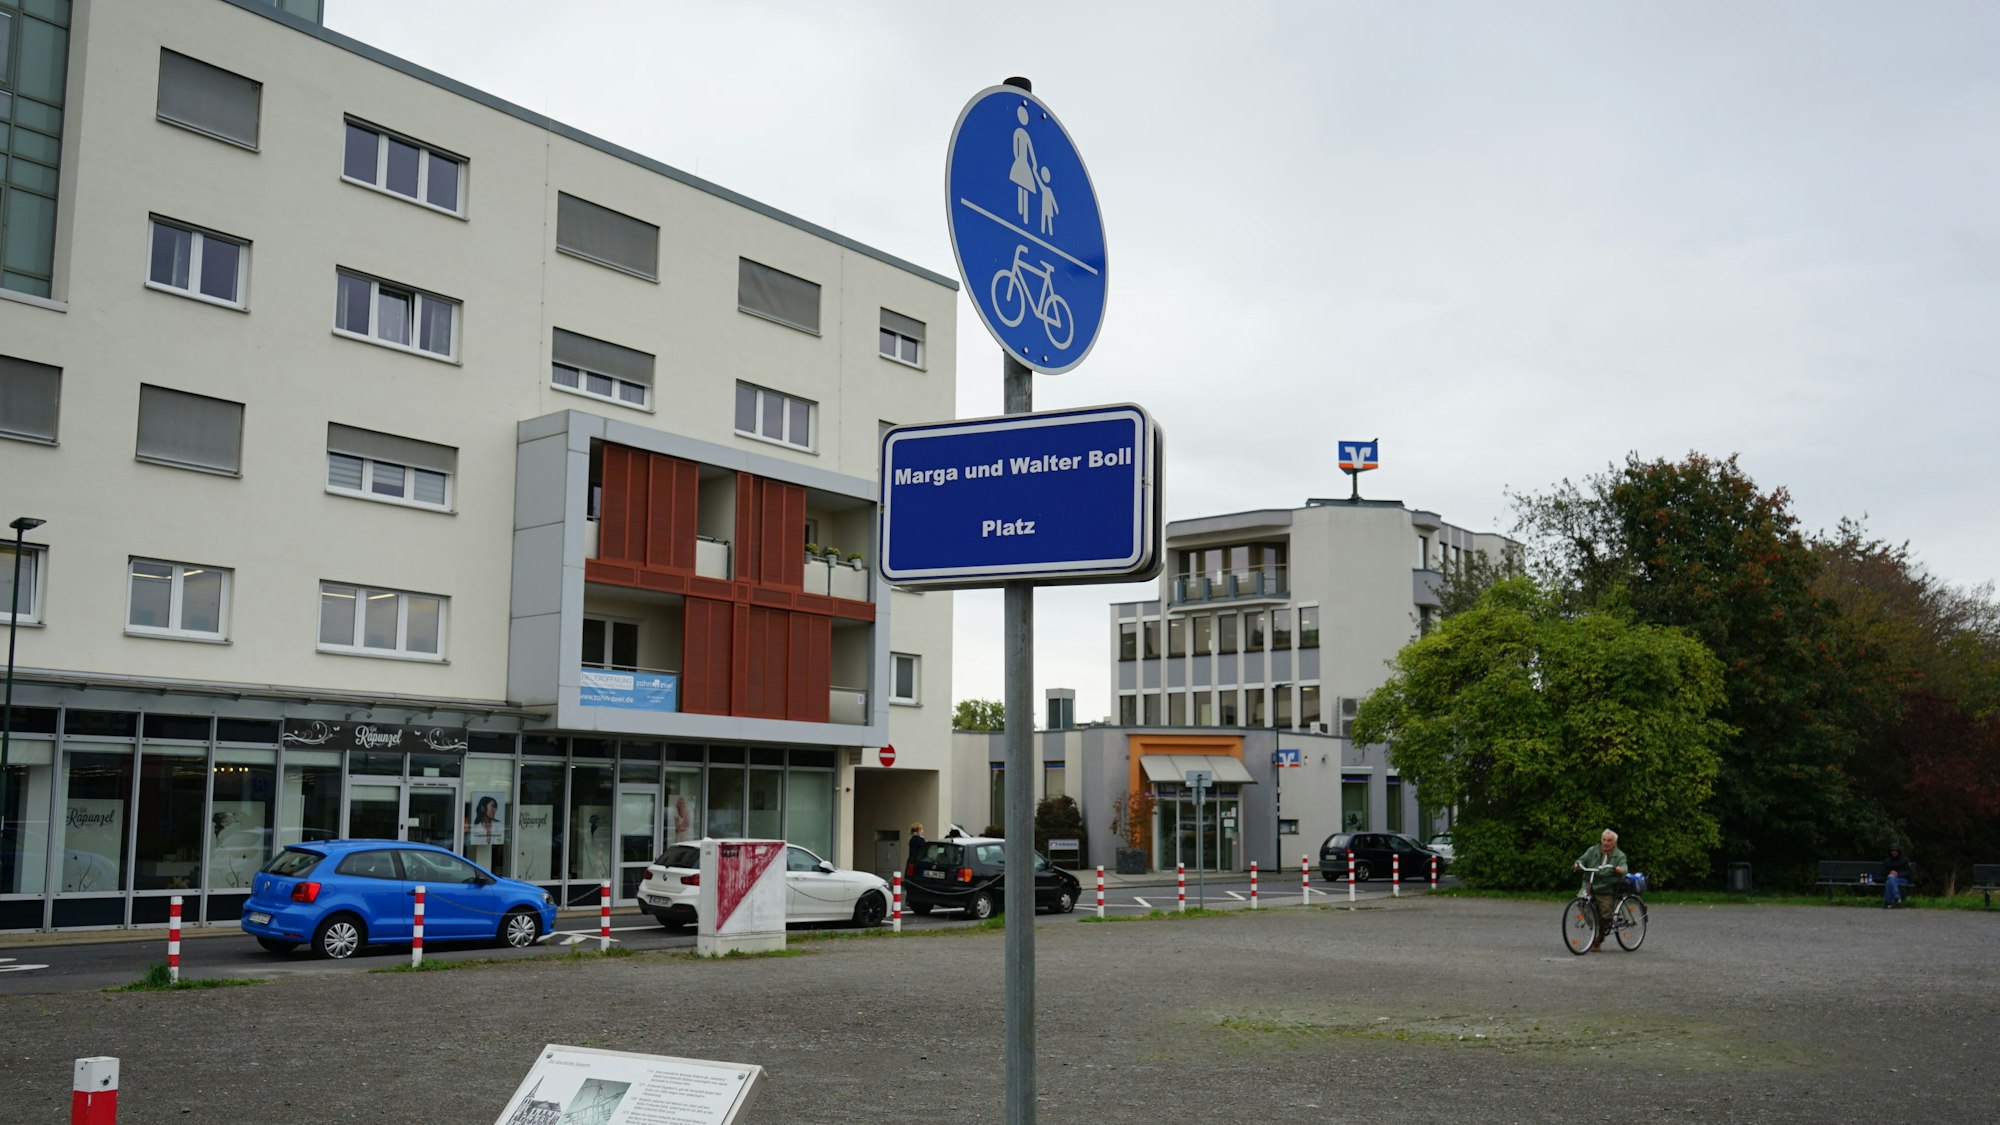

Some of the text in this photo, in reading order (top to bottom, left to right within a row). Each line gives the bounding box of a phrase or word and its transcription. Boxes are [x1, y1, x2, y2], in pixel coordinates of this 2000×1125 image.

[895, 447, 1132, 487] Marga und Walter Boll
[982, 517, 1036, 538] Platz
[355, 725, 403, 749] Rapunzel
[66, 807, 115, 829] Rapunzel
